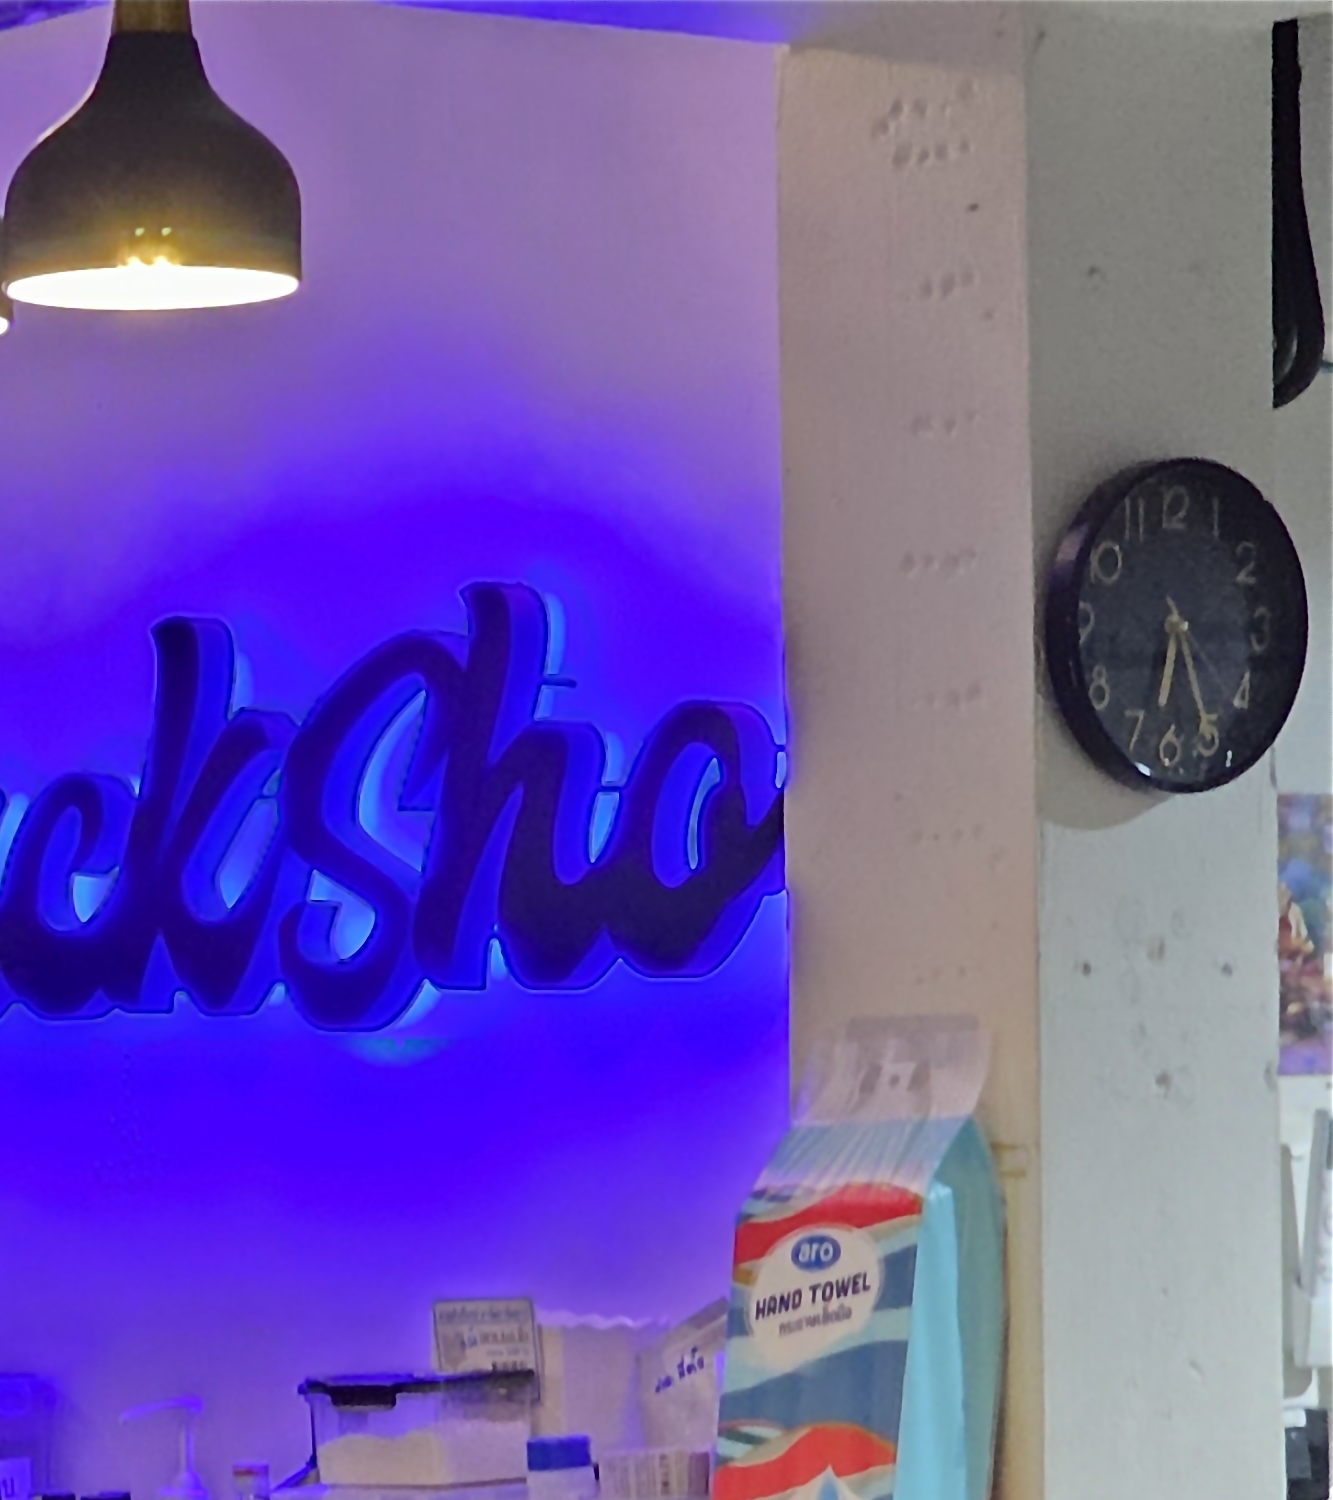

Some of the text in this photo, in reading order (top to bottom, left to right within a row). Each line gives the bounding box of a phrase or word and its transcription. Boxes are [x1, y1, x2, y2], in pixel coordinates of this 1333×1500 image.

[1124, 497, 1145, 542] 11
[1162, 485, 1190, 529] 12
[1211, 497, 1221, 538] 1
[1091, 541, 1122, 583] 10
[1235, 541, 1258, 583] 2
[1250, 607, 1271, 651] 3
[1089, 665, 1110, 710] 8
[1233, 670, 1250, 709] 4
[1125, 709, 1144, 752] 7
[1158, 723, 1182, 766] 6
[1197, 713, 1220, 757] 5
[798, 1241, 834, 1263] aro
[755, 1271, 871, 1320] HAND TOWEL
